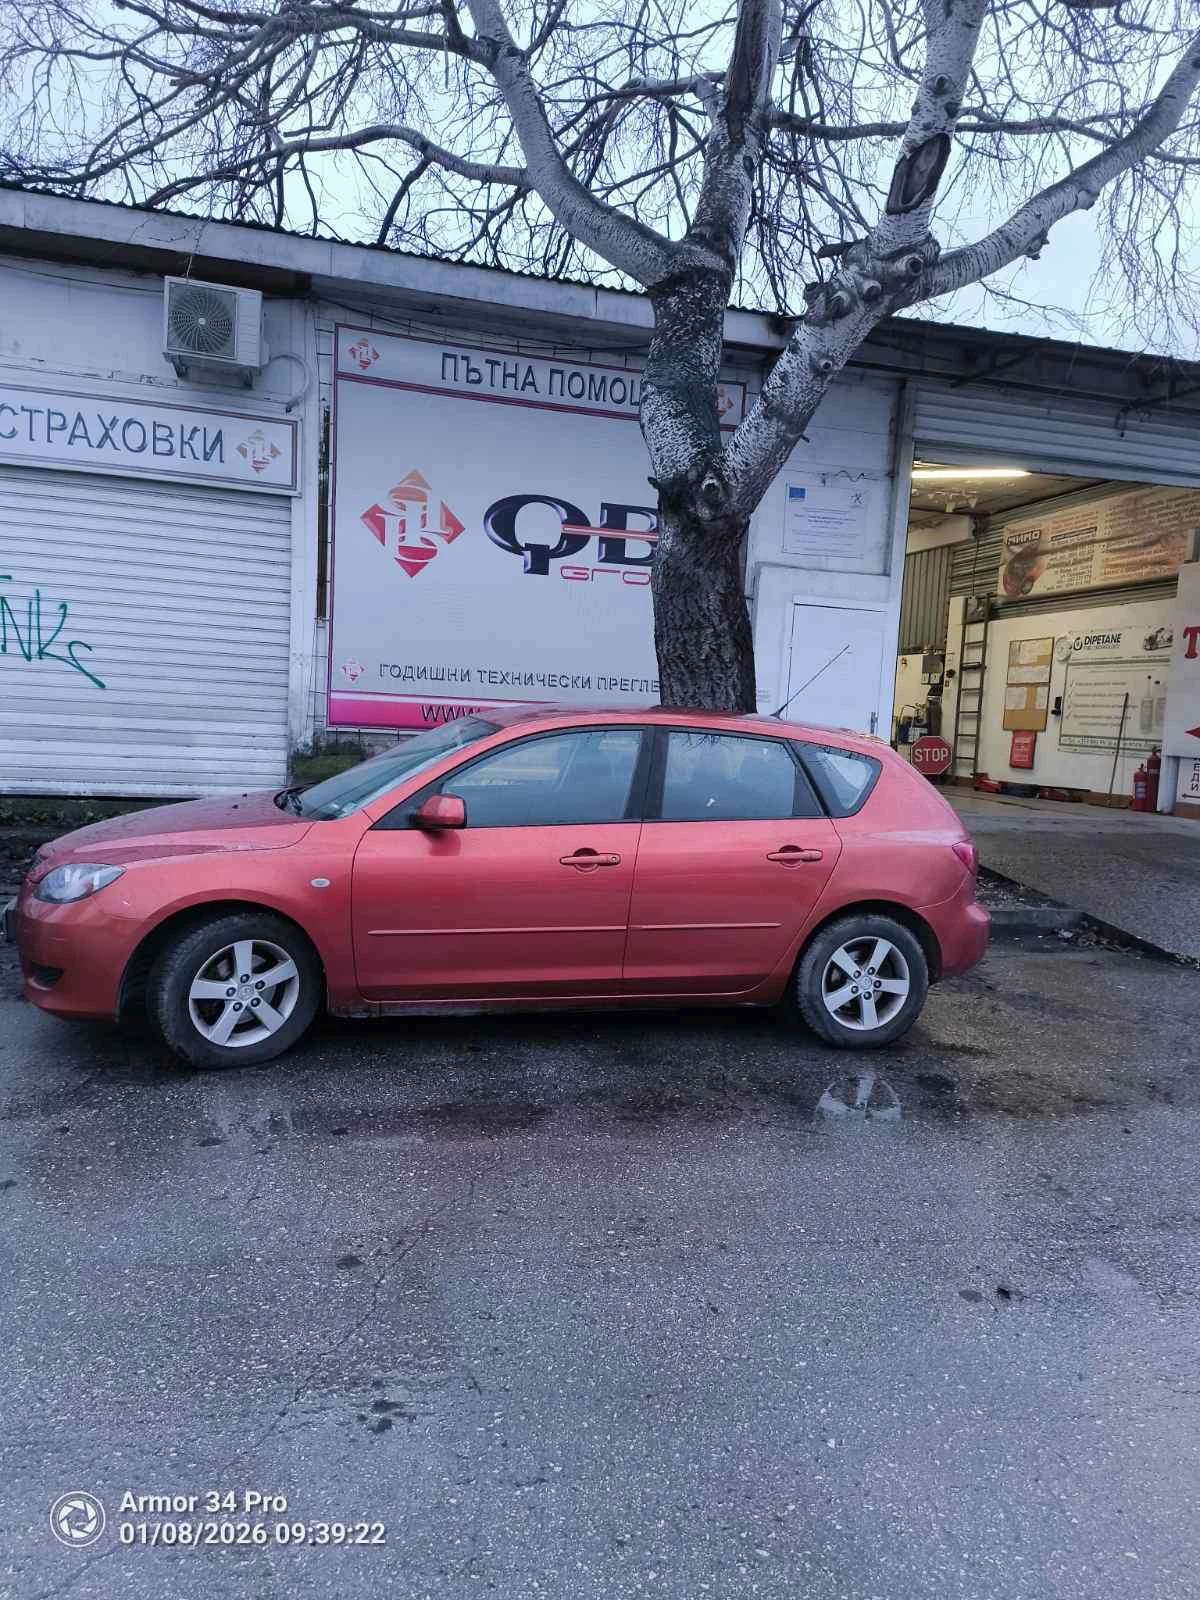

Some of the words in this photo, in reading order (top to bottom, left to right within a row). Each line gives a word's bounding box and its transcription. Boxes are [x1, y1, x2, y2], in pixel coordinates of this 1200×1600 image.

[441, 352, 539, 394] ПЪТНА
[1083, 633, 1122, 646] DIPETANE
[379, 663, 471, 682] ГОДИШНИ
[476, 669, 592, 689] ТЕХНИЧЕСКИ
[914, 747, 949, 762] STOP
